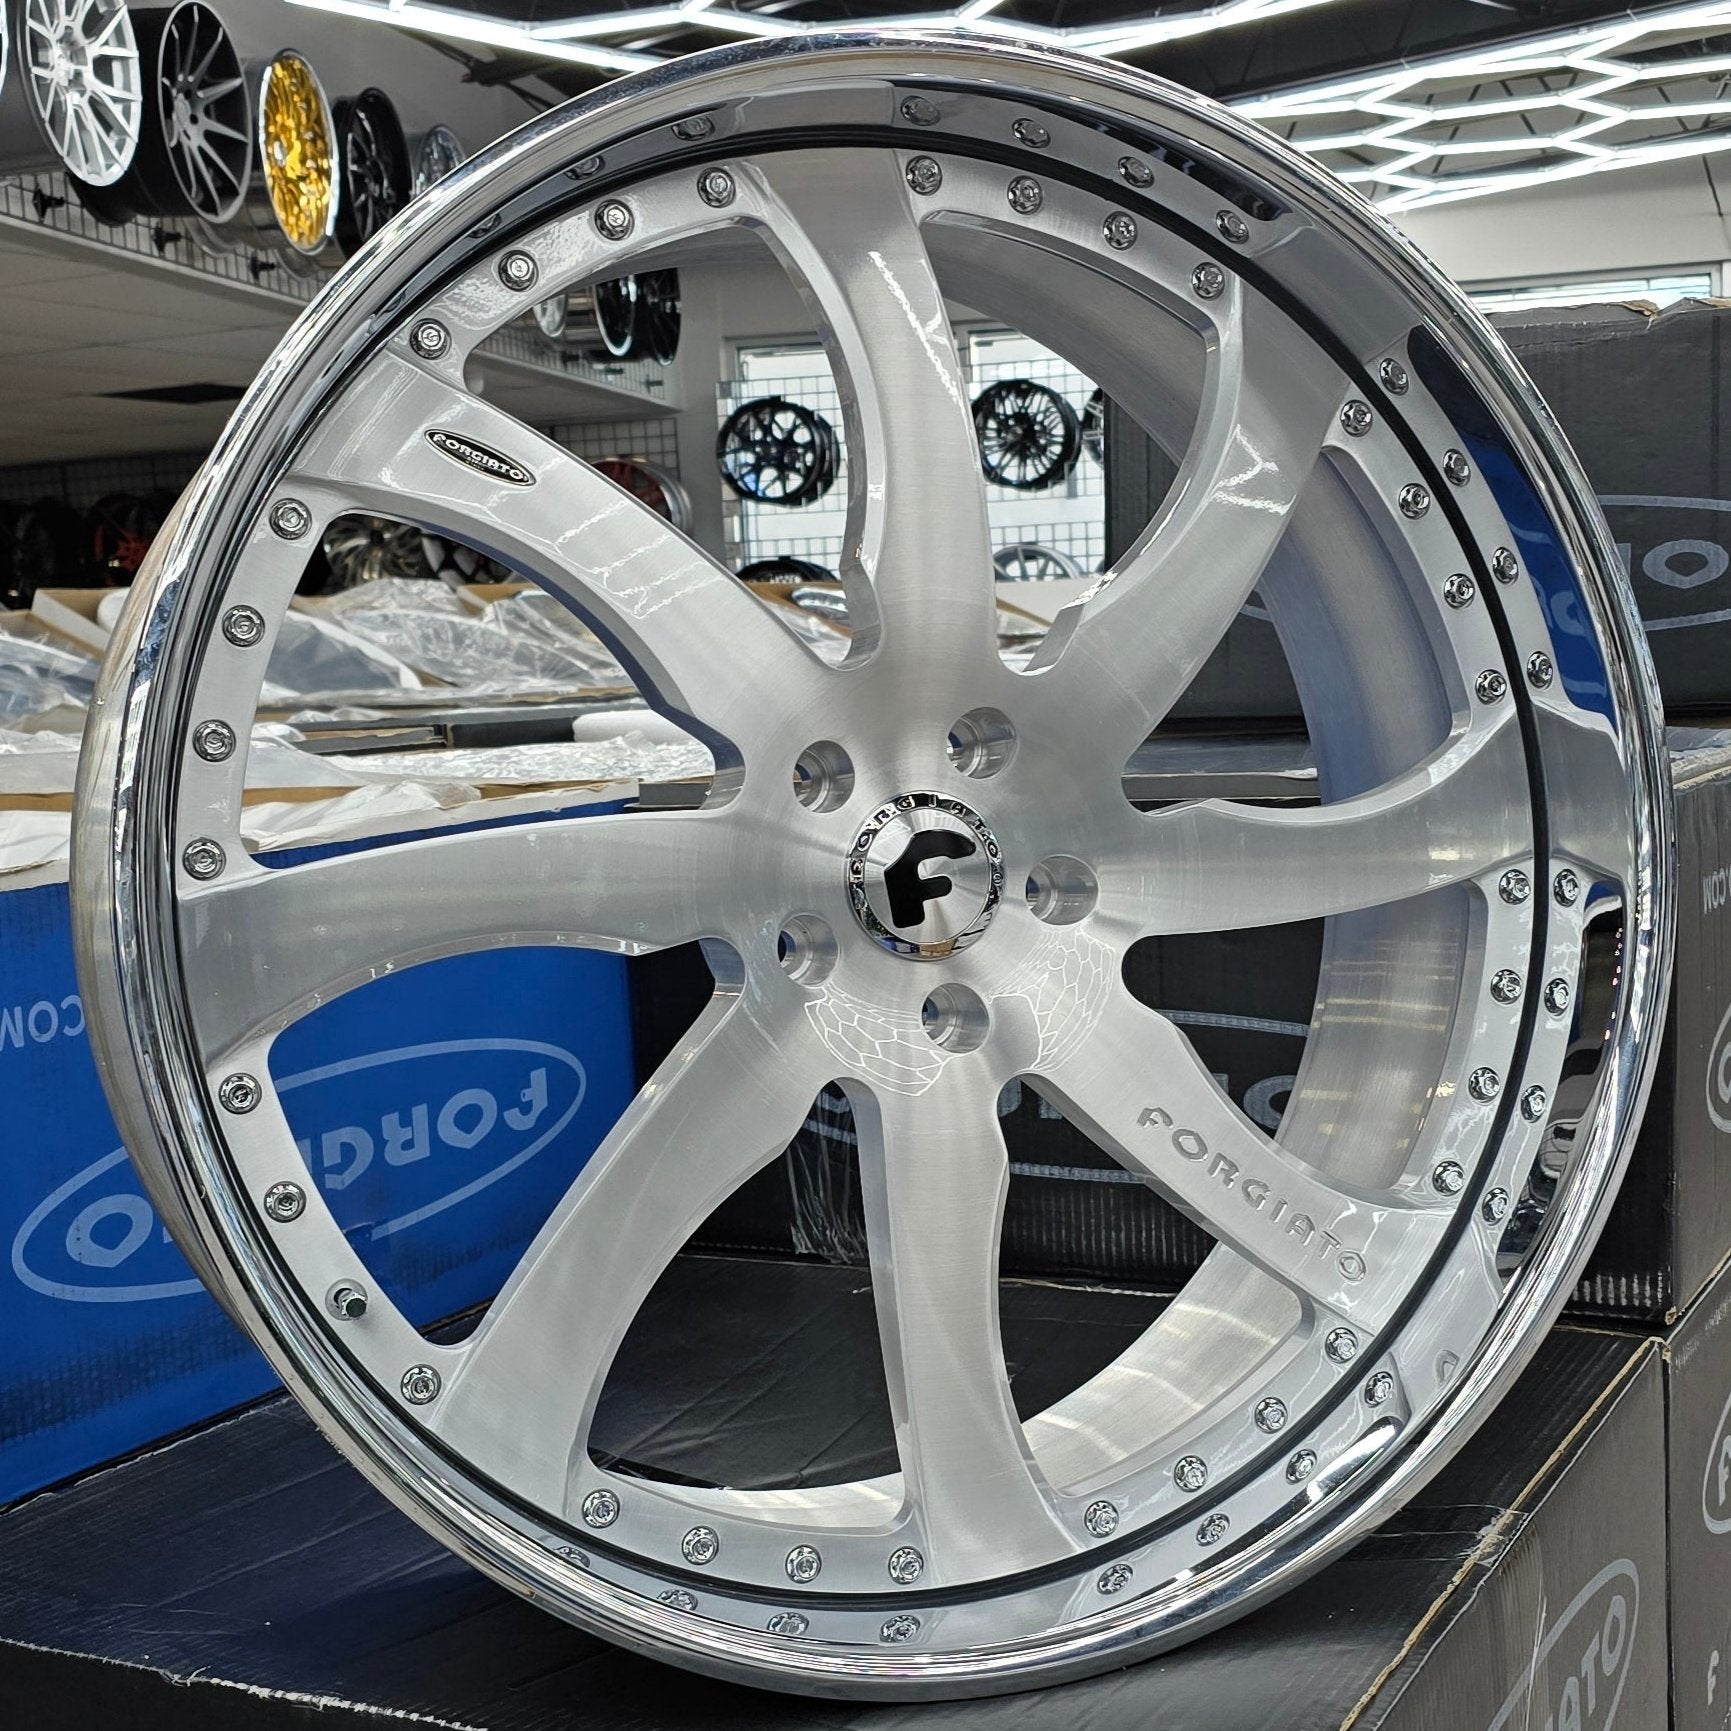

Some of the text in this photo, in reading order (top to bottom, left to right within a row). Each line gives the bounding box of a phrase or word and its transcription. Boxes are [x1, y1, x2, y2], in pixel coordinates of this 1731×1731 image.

[432, 433, 524, 481] FORGIATO
[66, 1067, 549, 1267] FORGO
[1136, 1106, 1367, 1283] FORGIATO
